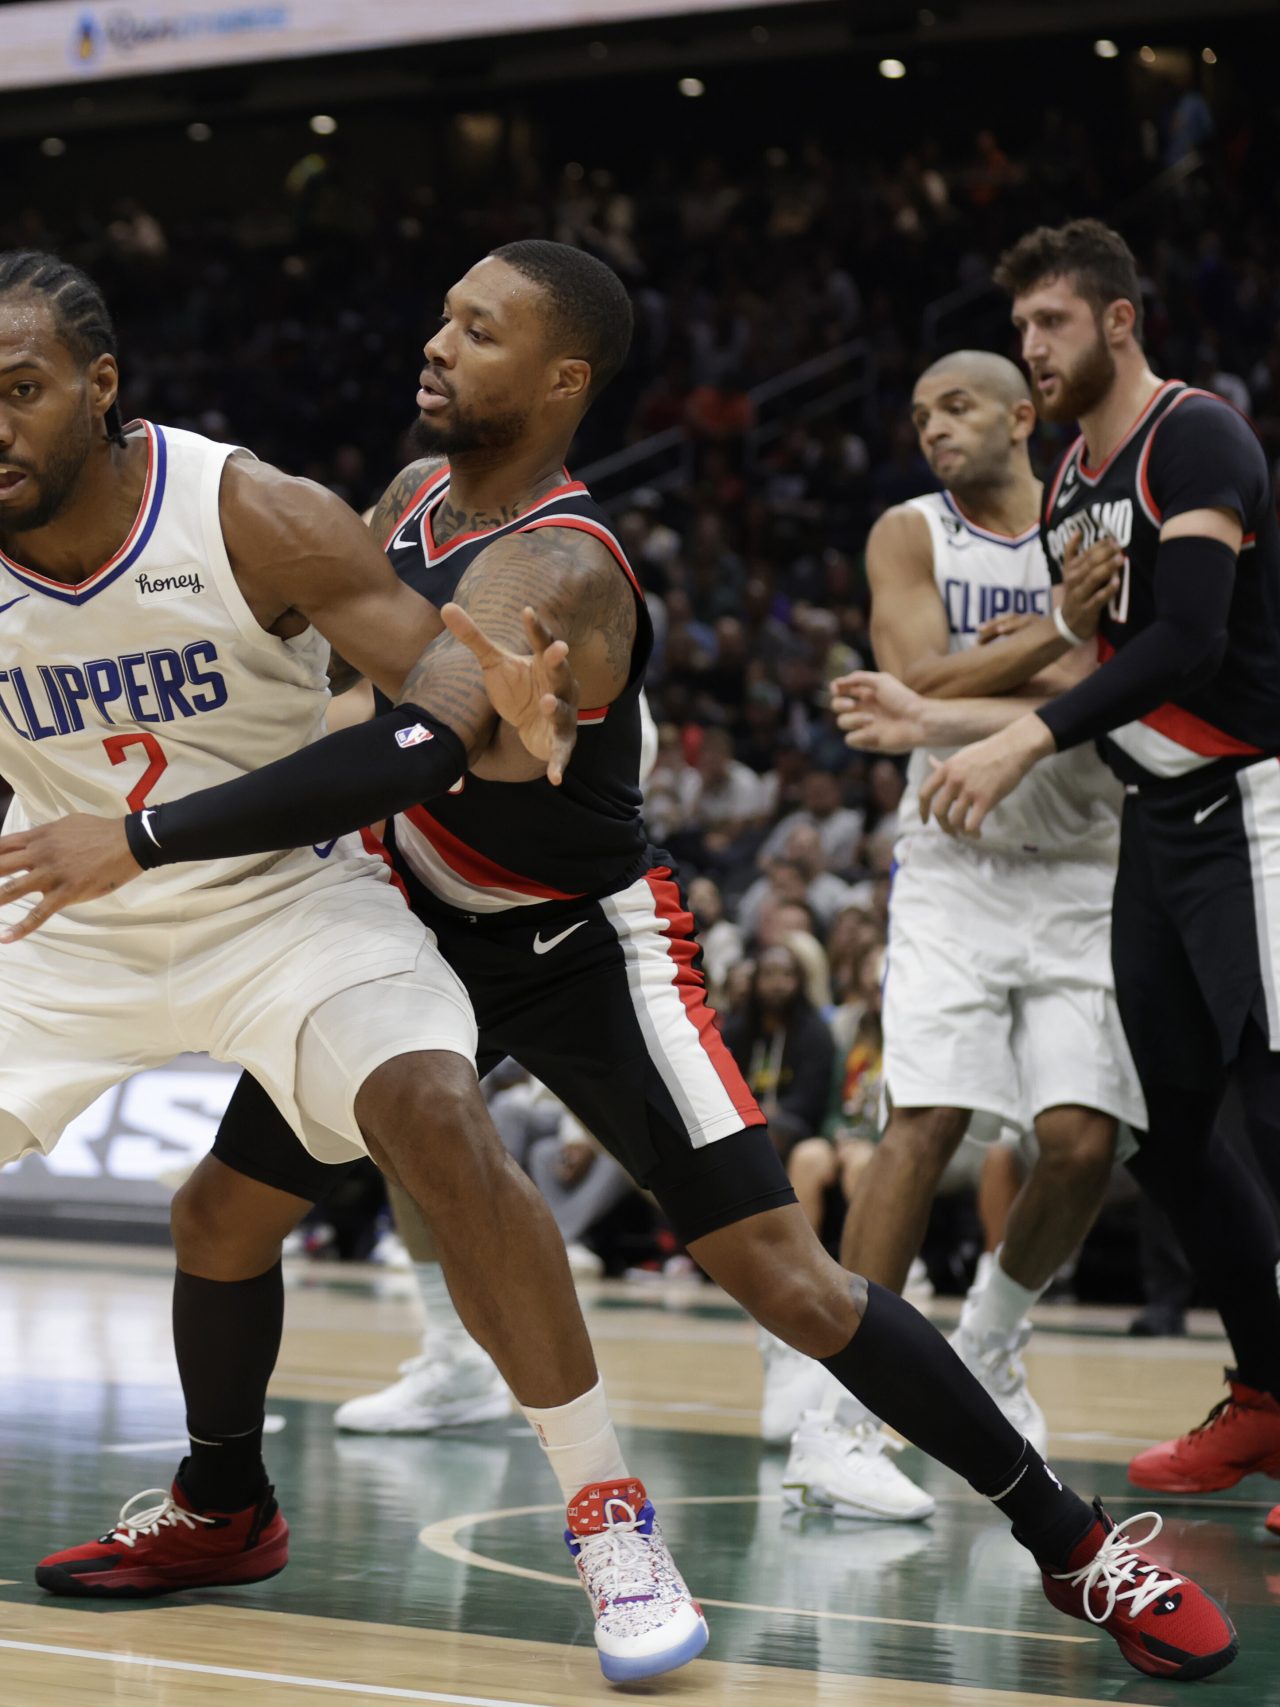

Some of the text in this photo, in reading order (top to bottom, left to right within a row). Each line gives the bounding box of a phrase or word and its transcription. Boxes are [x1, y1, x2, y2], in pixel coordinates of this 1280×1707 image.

[135, 572, 205, 595] honey
[945, 578, 1052, 634] CLIPPE
[102, 732, 169, 814] 2
